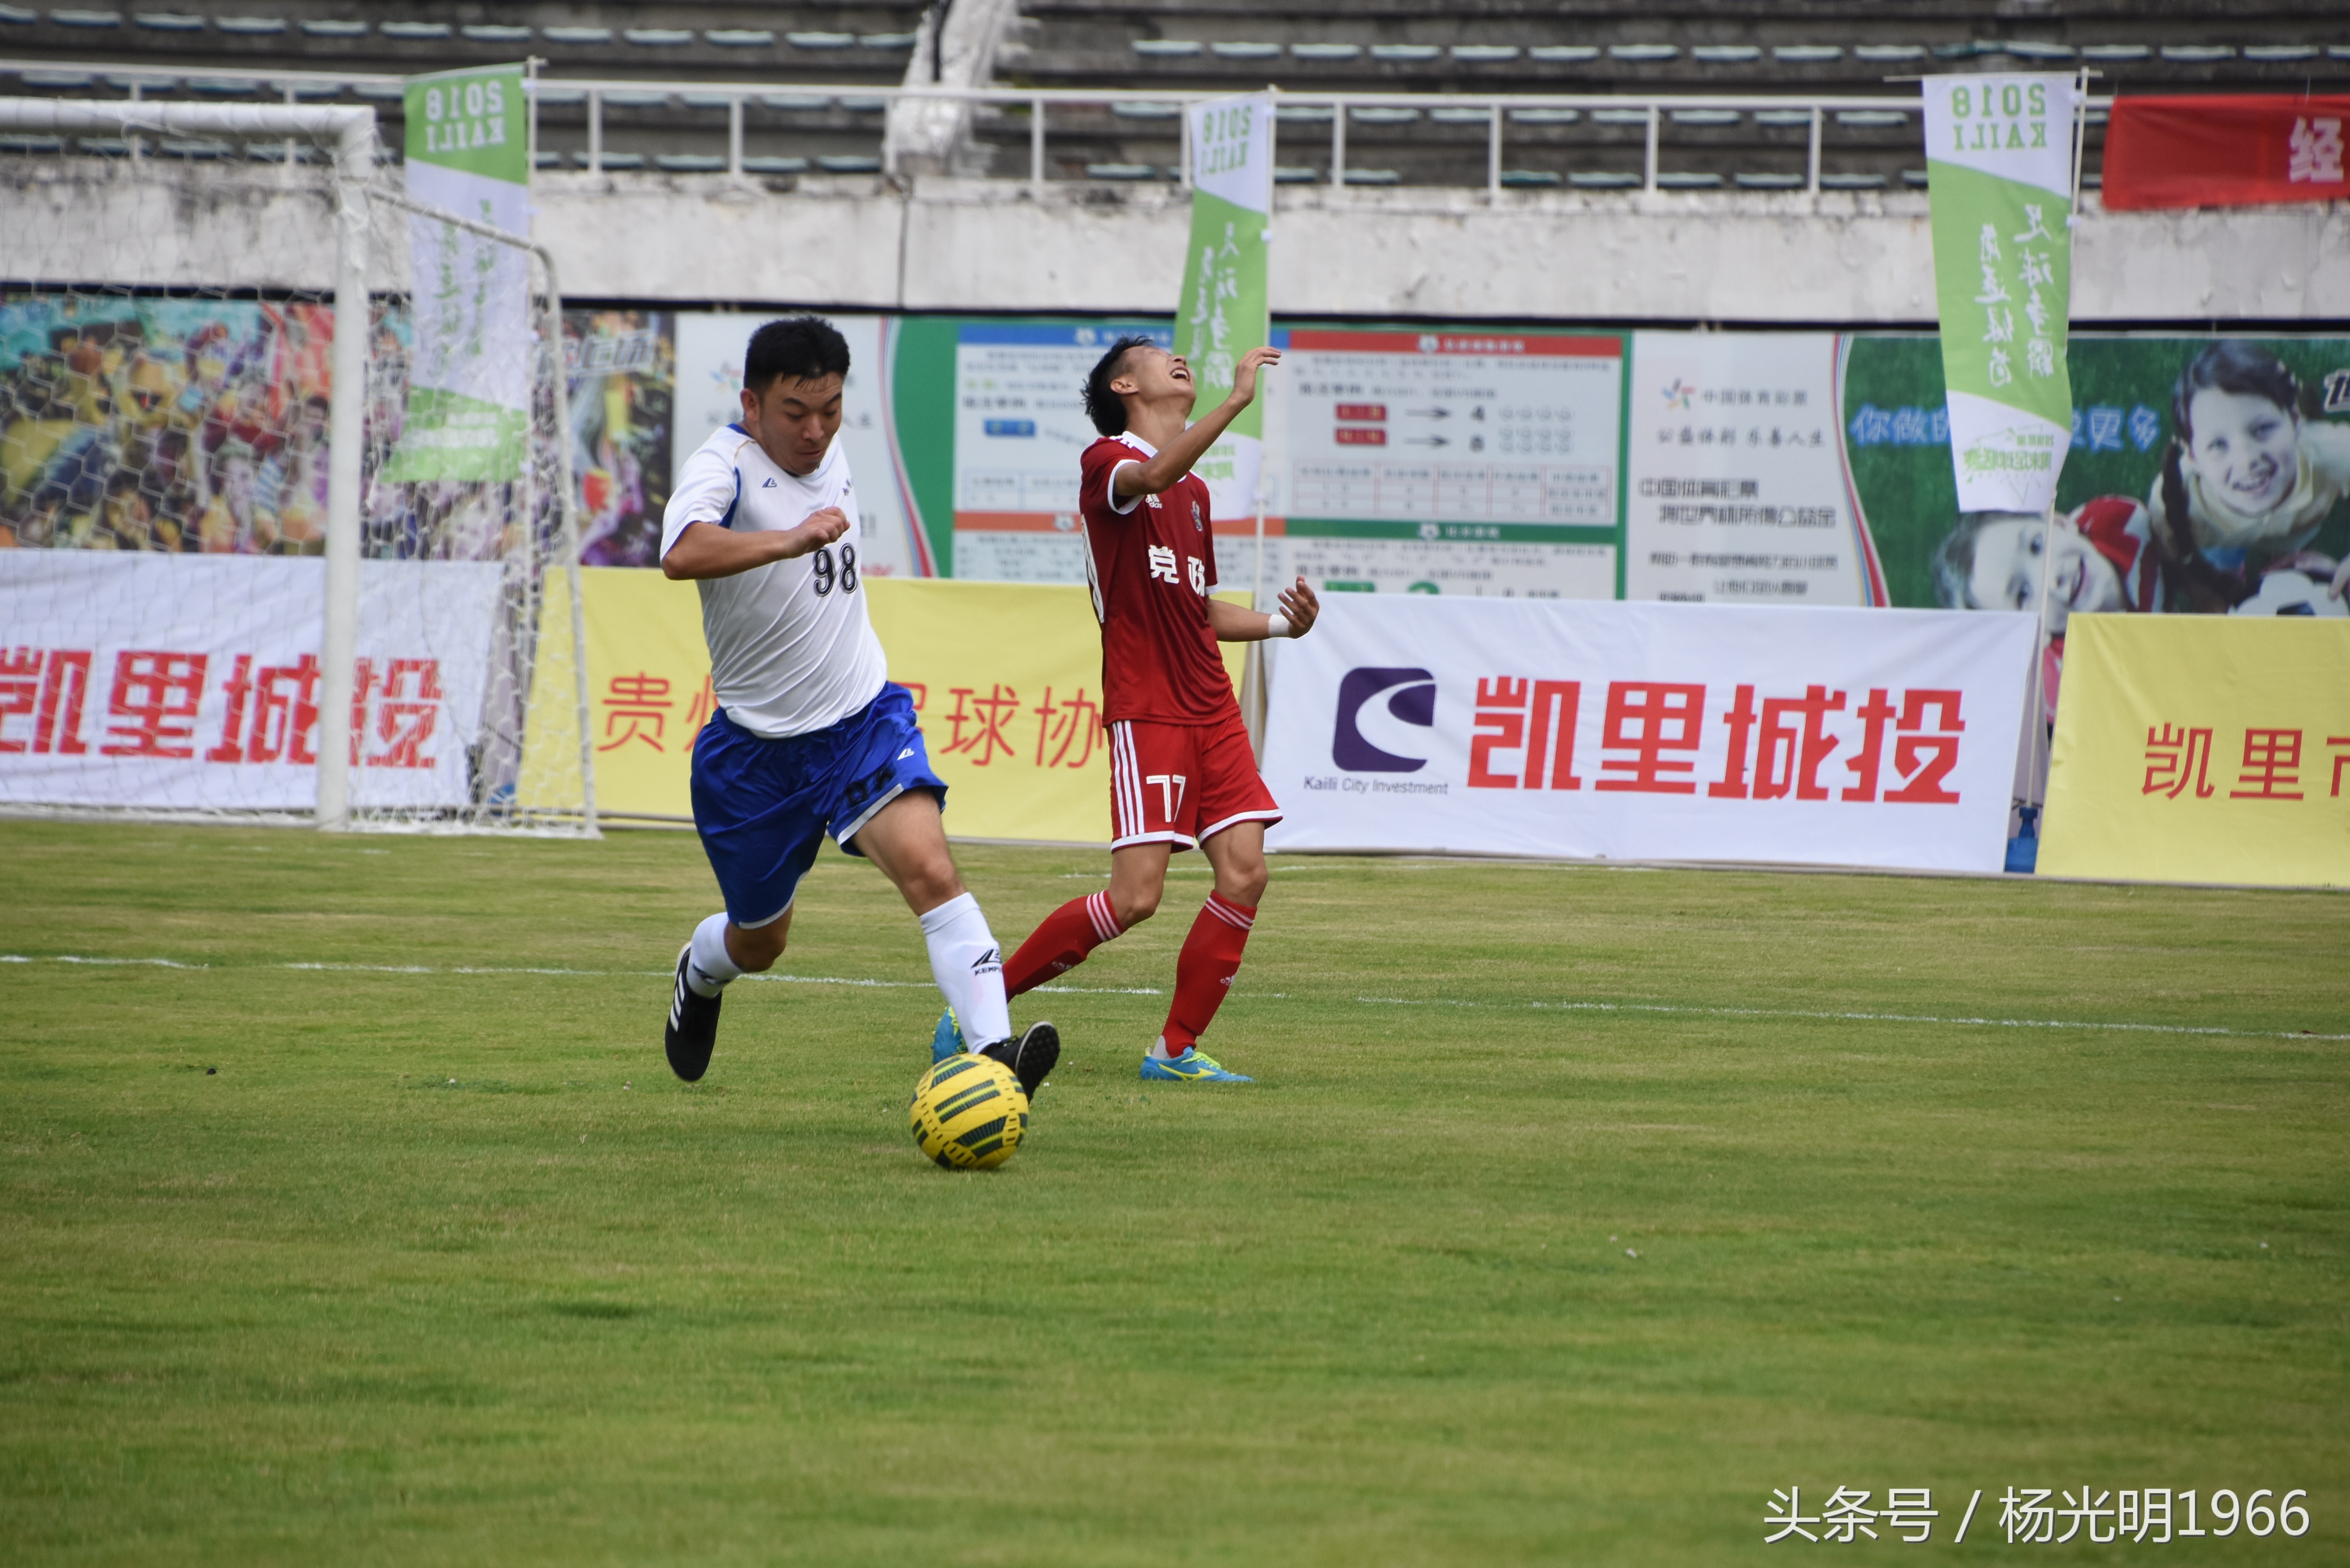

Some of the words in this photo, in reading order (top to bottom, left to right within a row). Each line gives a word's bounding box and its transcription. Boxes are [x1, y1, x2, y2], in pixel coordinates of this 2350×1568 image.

[2289, 117, 2344, 183] 经
[813, 543, 858, 597] 98
[1468, 676, 1965, 804] 凯里城投
[1146, 774, 1186, 823] 77
[1304, 776, 1338, 791] Kaili
[1342, 778, 1368, 794] City
[1372, 779, 1448, 795] Investment
